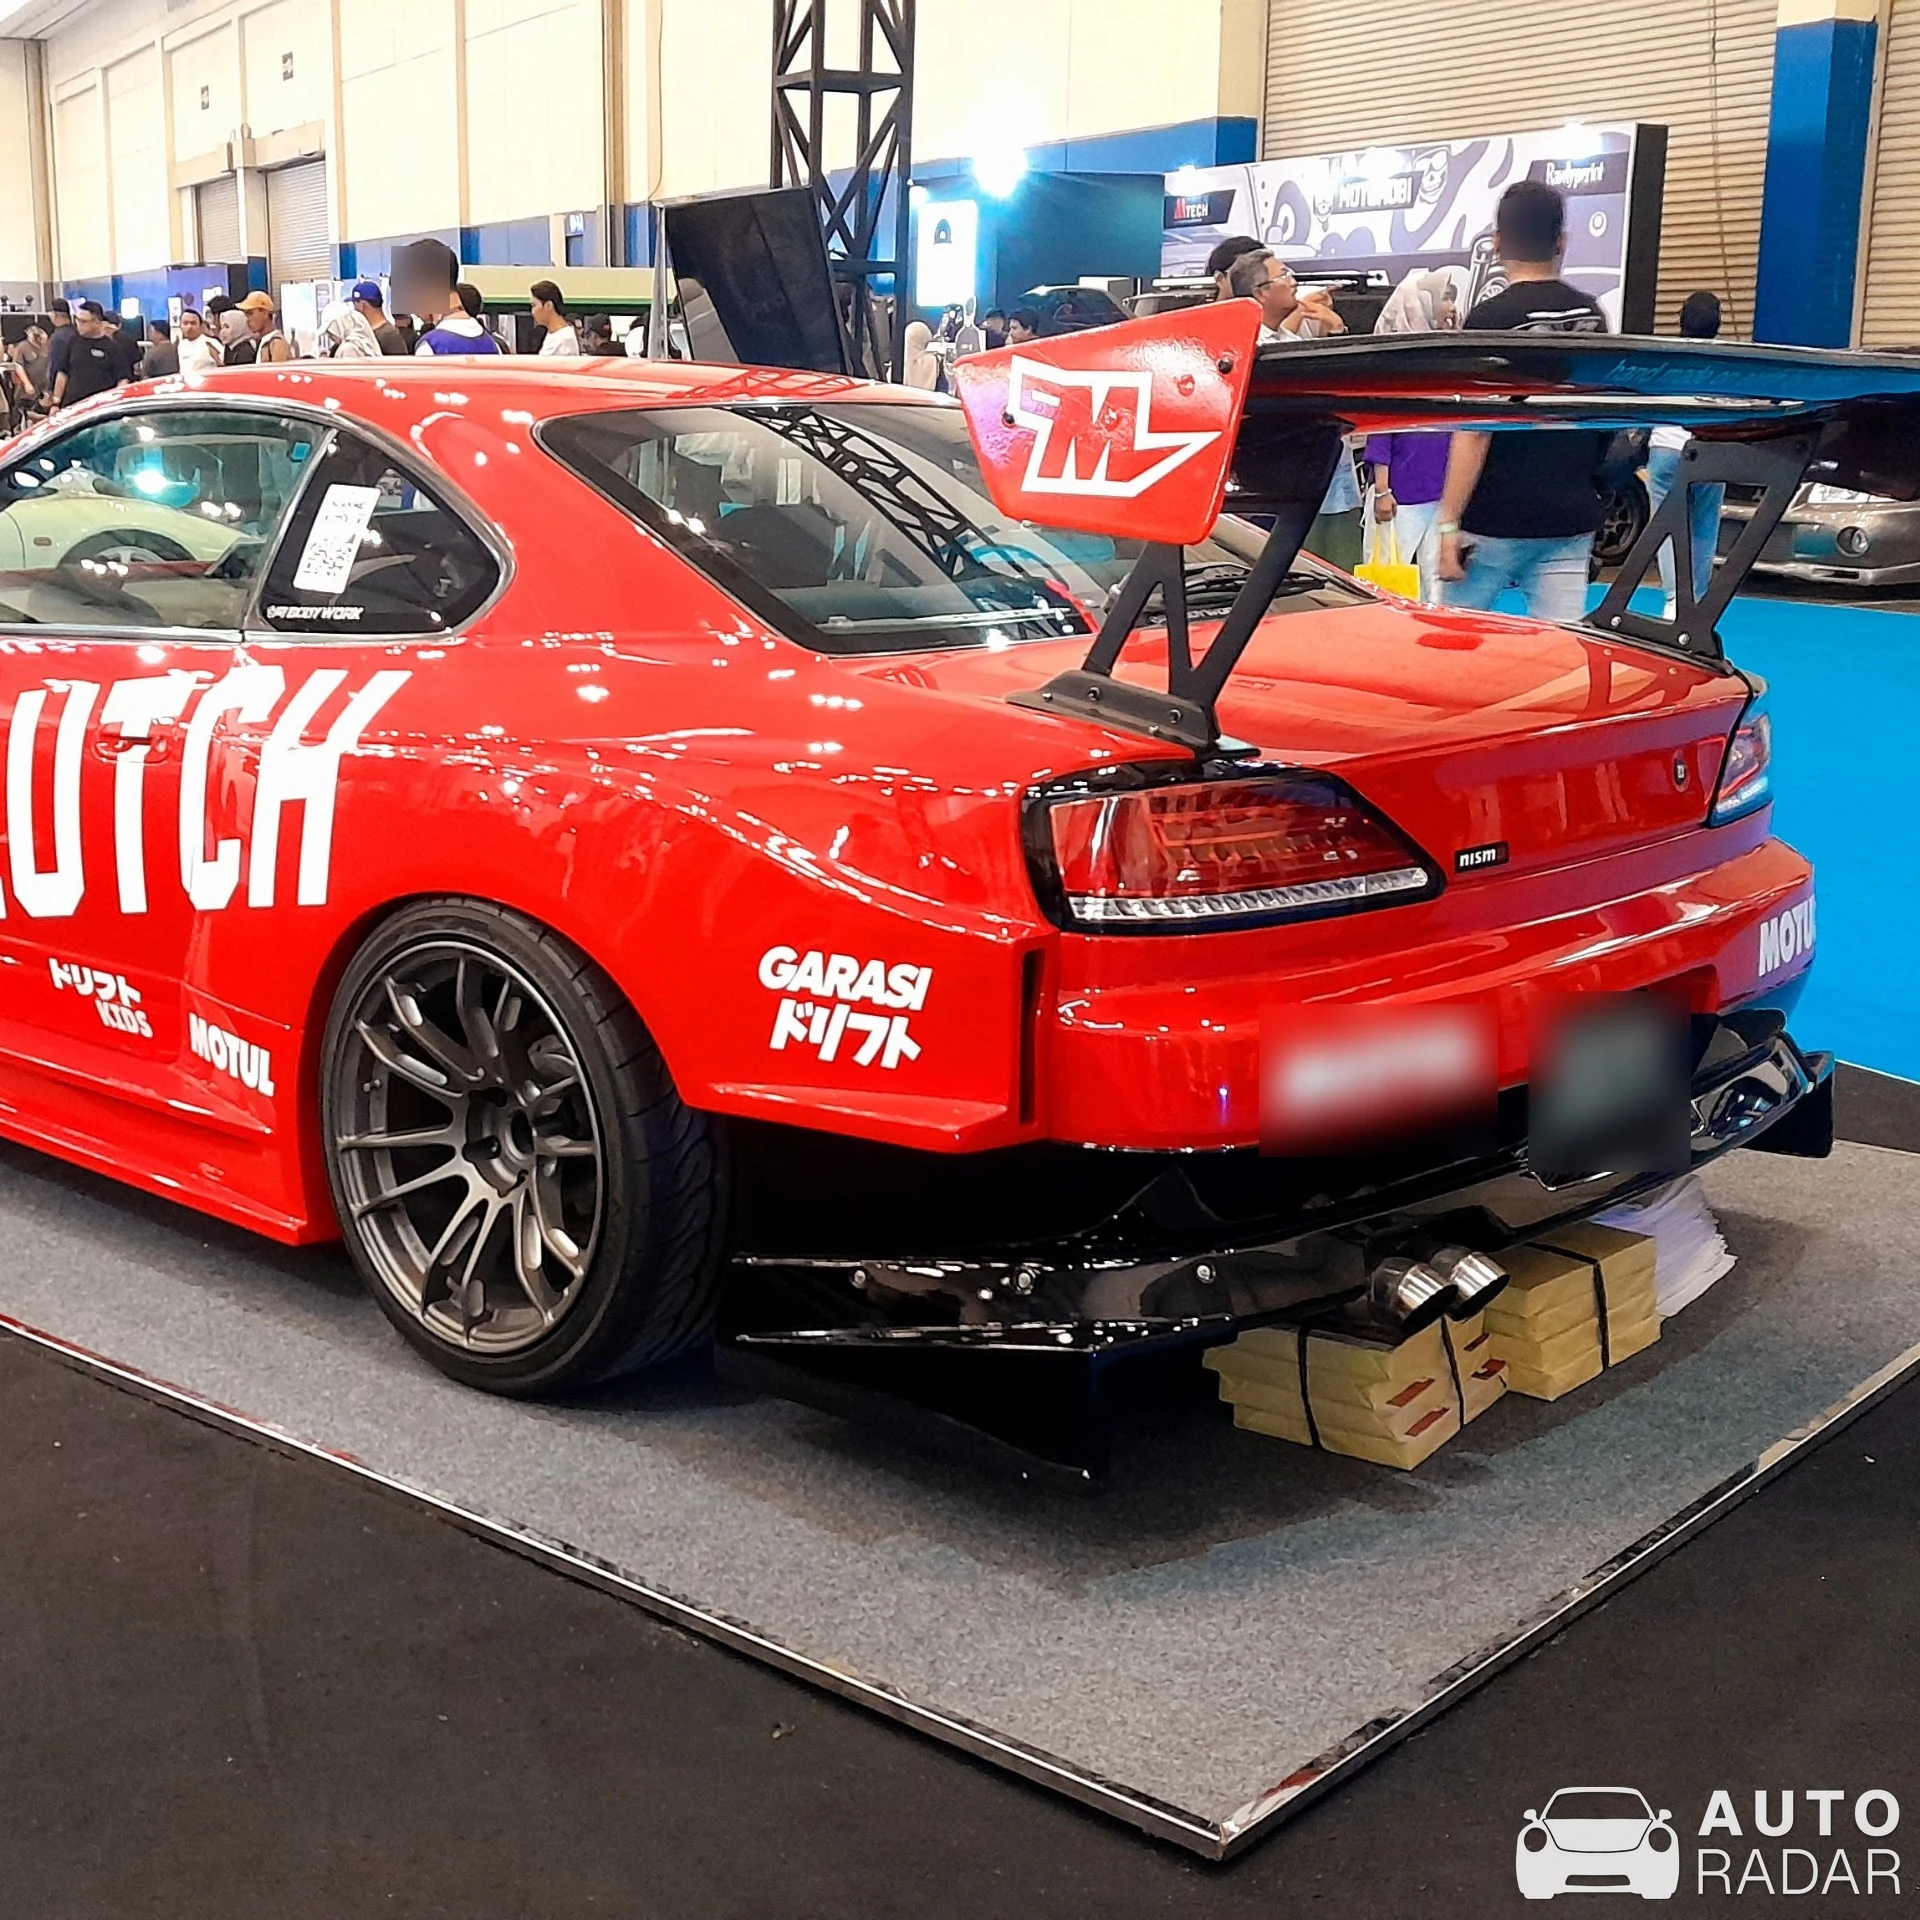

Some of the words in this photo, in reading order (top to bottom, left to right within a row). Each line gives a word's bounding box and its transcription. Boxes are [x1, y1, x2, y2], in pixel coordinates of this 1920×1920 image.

[0, 665, 412, 918] UTCH
[48, 957, 142, 1007] ドリフト
[758, 945, 933, 1011] GARASI
[95, 999, 153, 1038] KIDS
[769, 998, 922, 1069] ドリフト
[189, 1012, 276, 1097] MOTUL
